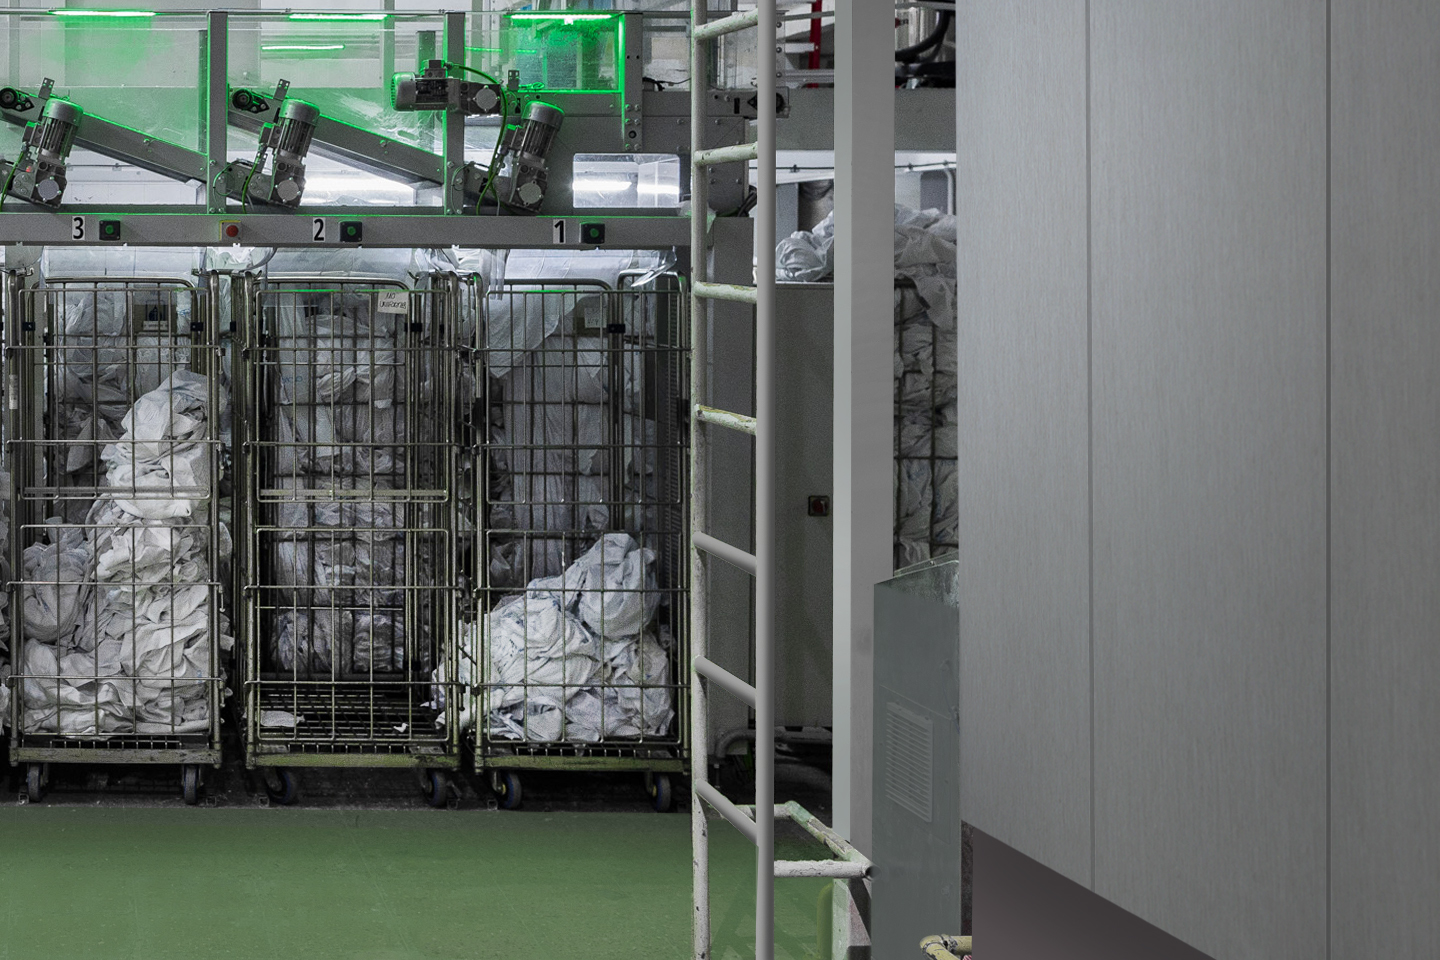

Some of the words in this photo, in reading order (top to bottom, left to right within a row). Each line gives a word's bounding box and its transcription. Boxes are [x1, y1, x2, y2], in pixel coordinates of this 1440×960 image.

[73, 216, 84, 240] 3
[313, 218, 325, 242] 2
[554, 220, 565, 244] 1
